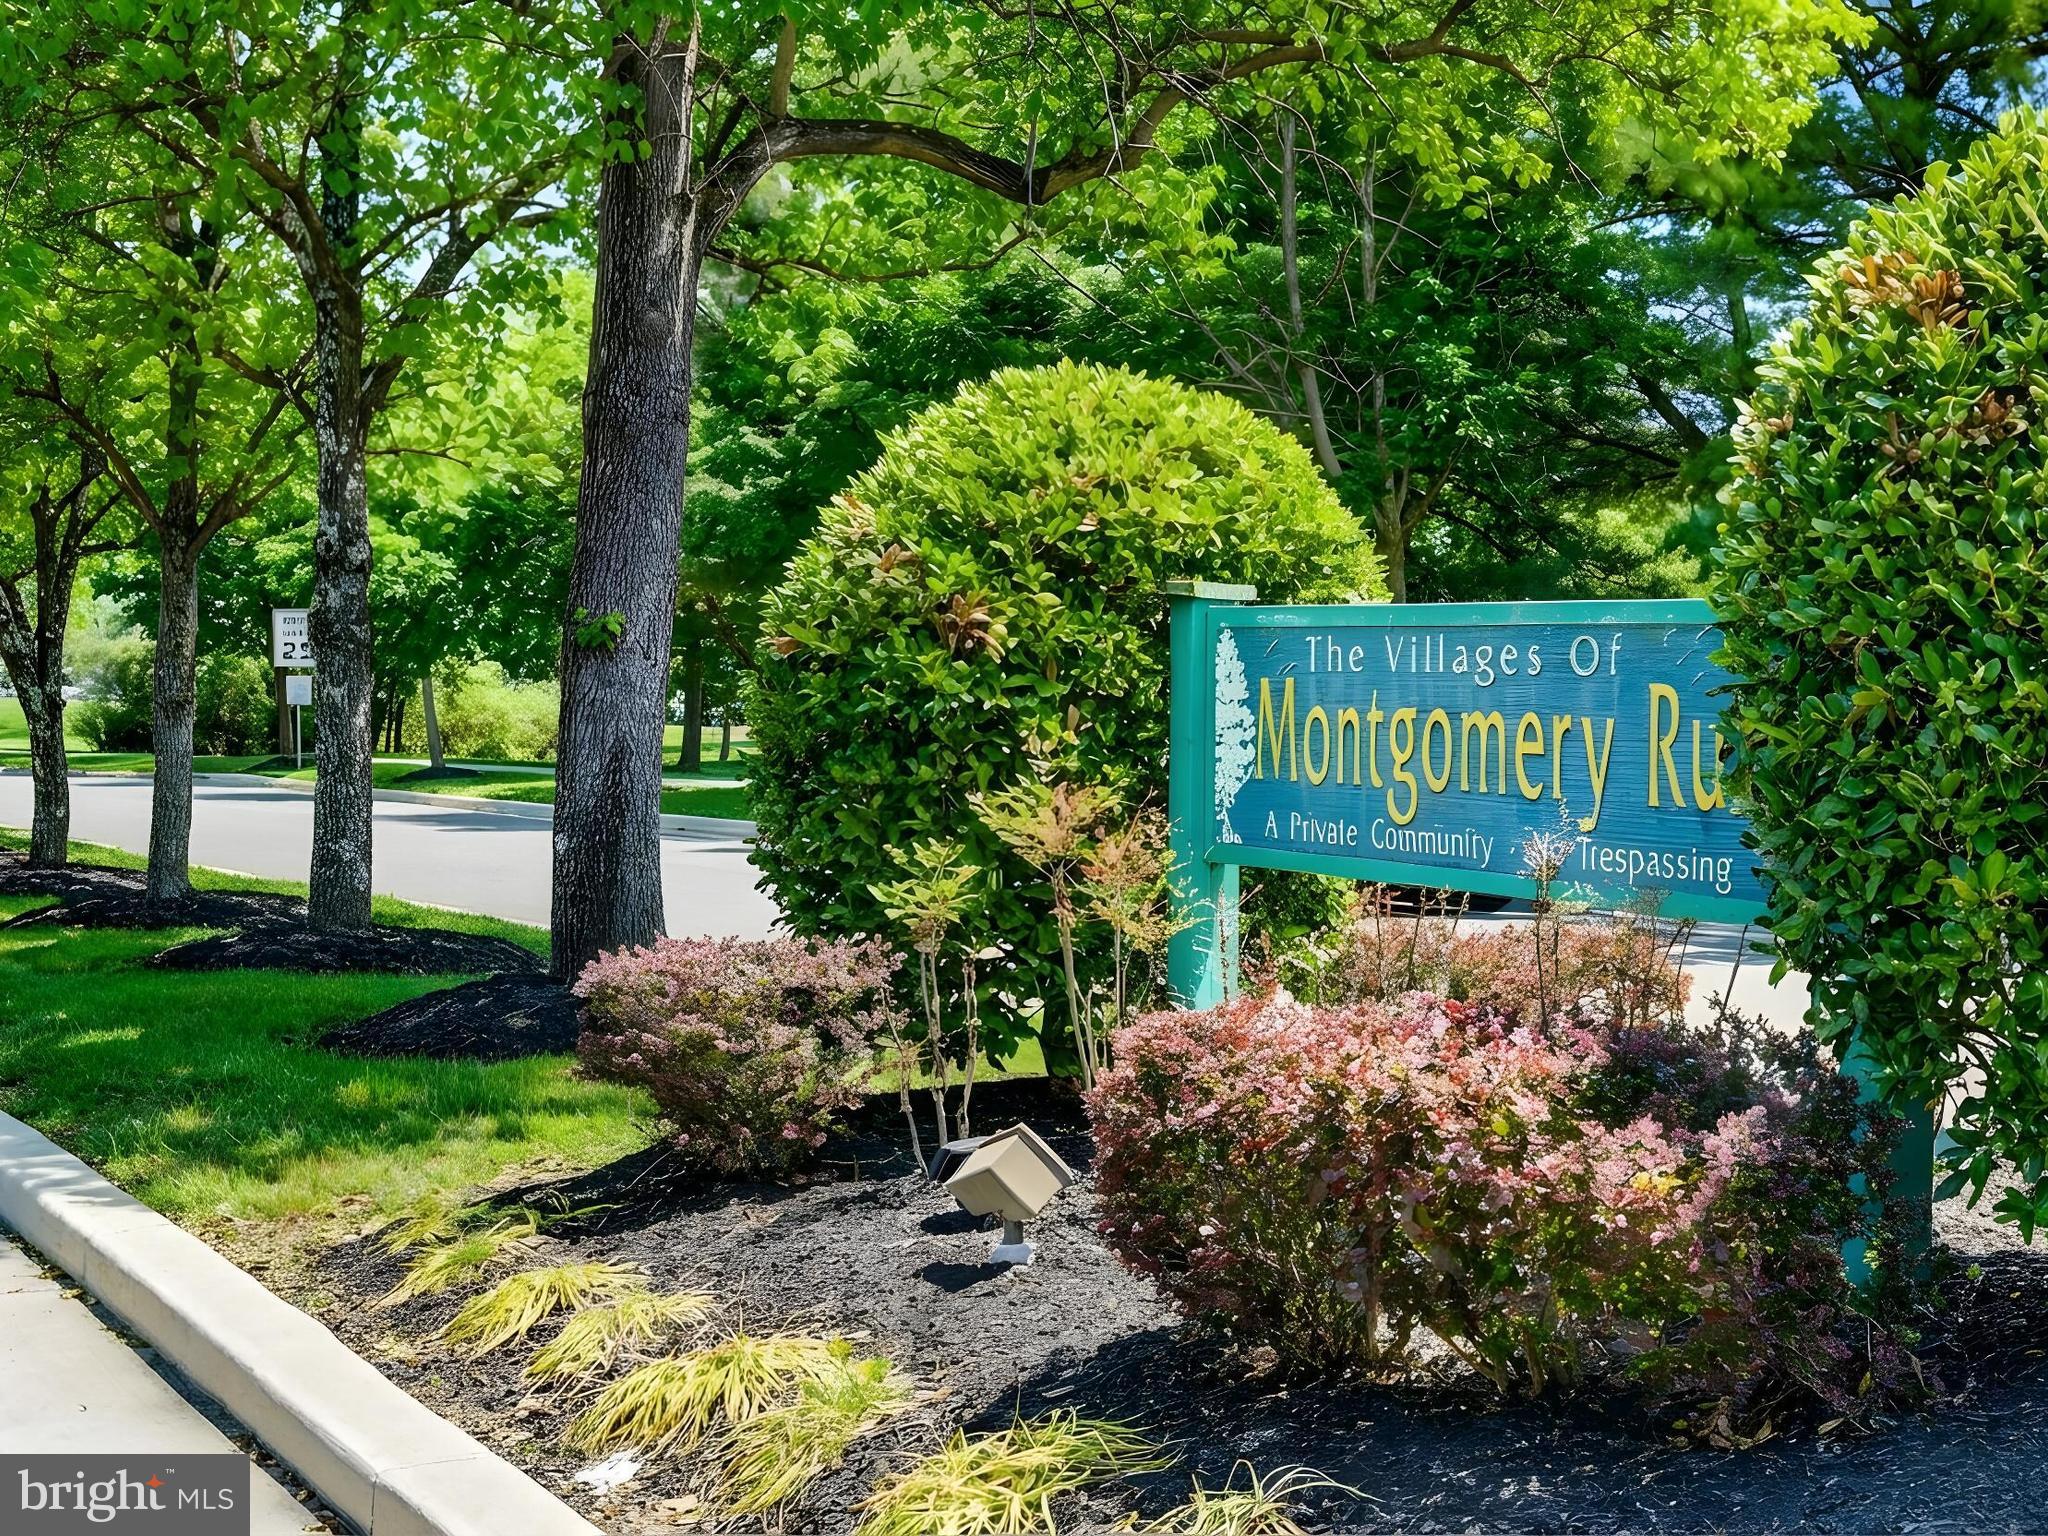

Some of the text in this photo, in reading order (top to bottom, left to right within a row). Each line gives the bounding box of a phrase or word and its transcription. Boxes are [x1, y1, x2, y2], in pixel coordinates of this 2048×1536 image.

[1305, 632, 1622, 687] The Villages Of
[1254, 676, 1727, 832] Montgomery Ru
[1264, 810, 1278, 839] A
[1290, 811, 1358, 846] Private
[1371, 818, 1494, 869] Community
[1575, 836, 1733, 895] Trespassing
